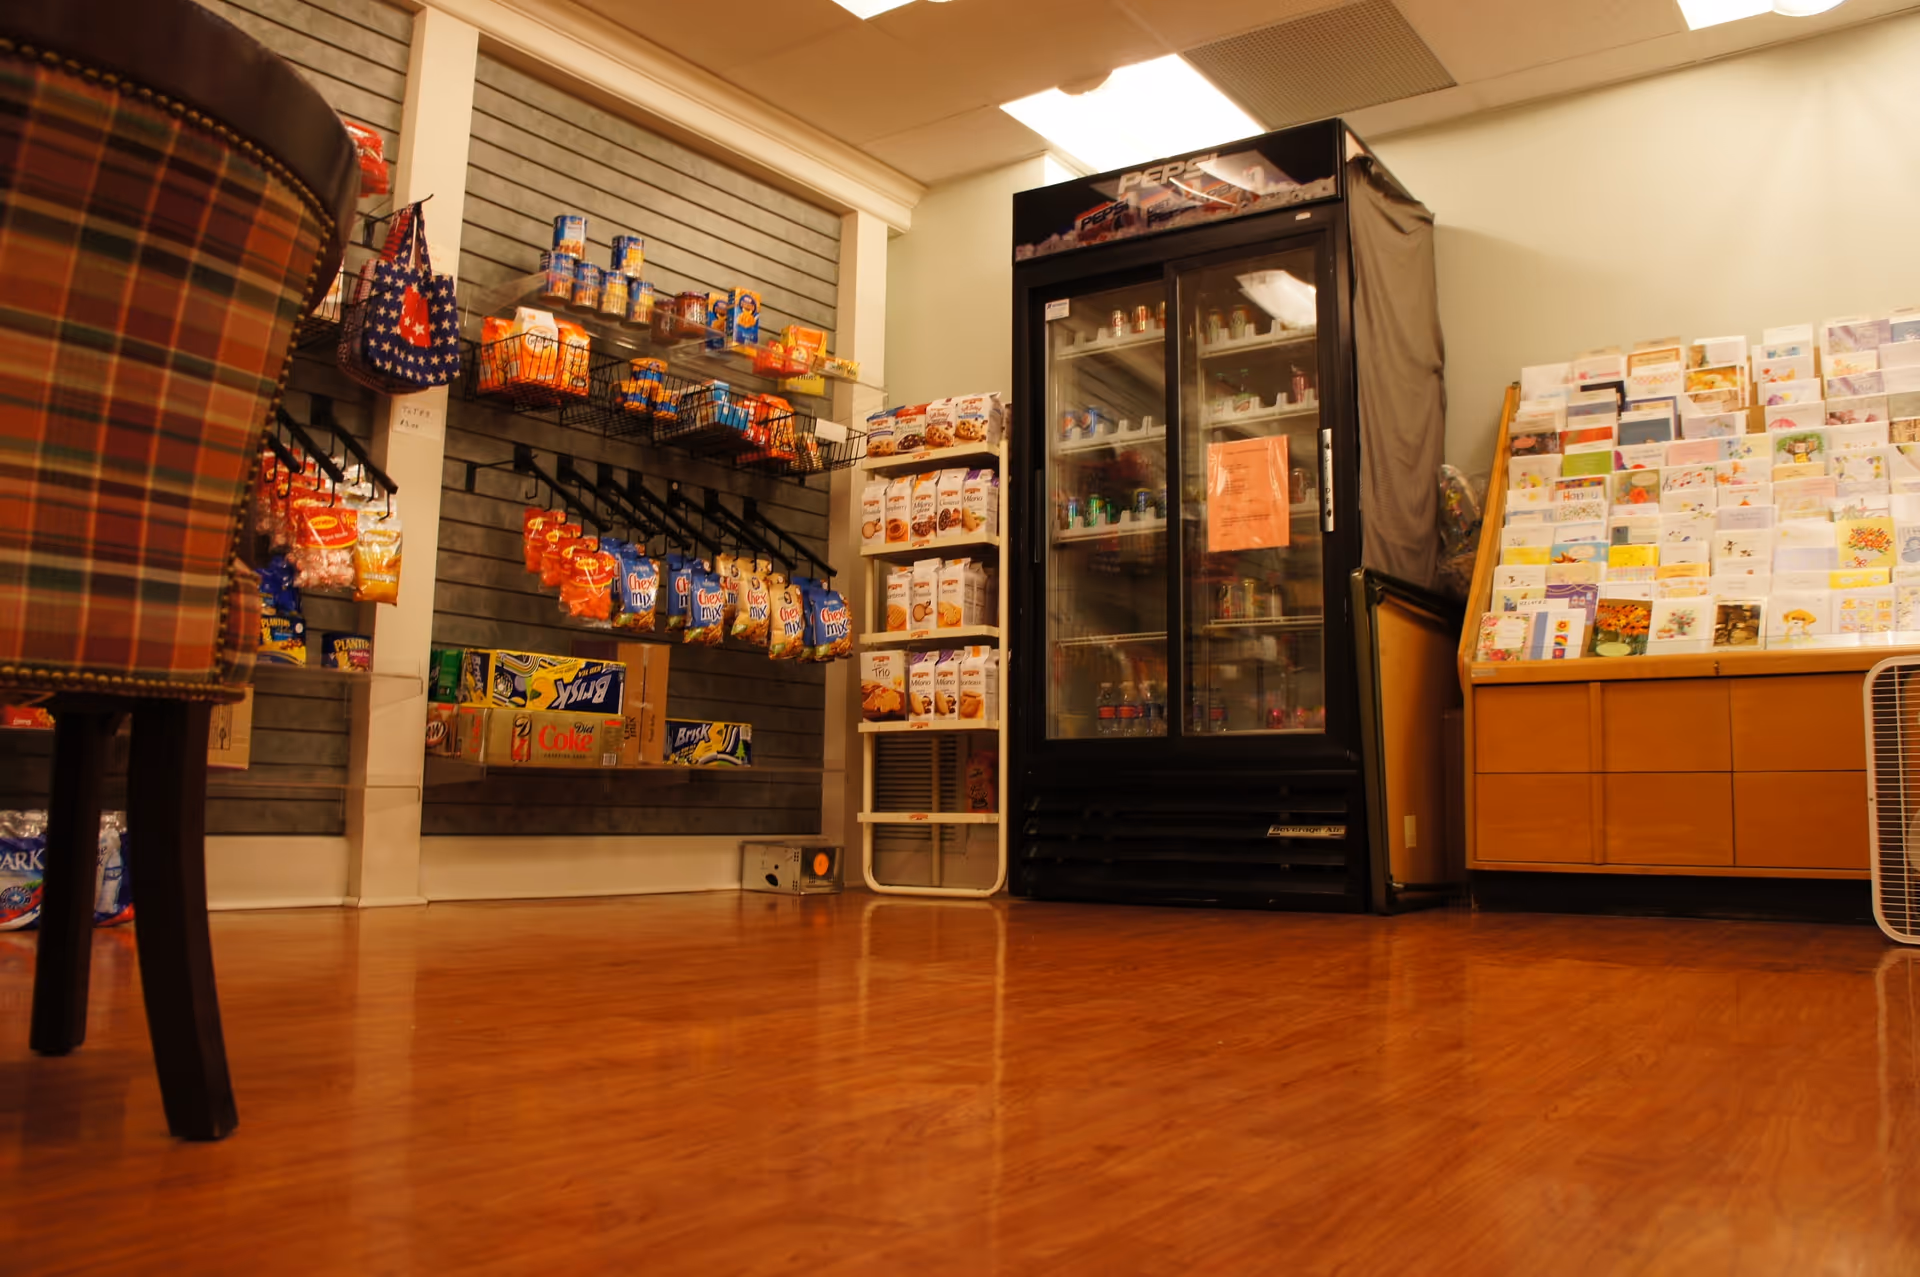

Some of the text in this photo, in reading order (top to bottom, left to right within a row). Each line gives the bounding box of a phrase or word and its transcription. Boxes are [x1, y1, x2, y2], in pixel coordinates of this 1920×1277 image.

[675, 576, 690, 595] Ch
[724, 576, 739, 593] Che
[697, 589, 724, 606] Chex
[746, 588, 768, 605] Chex
[700, 603, 723, 622] mix
[749, 604, 768, 620] mix
[779, 605, 800, 623] Chex
[820, 607, 846, 625] Chex
[784, 618, 802, 637] mix
[825, 618, 850, 637] mix
[871, 667, 891, 679] Trio
[574, 722, 595, 734] Diet
[538, 725, 594, 752] Coke
[0, 848, 44, 870] ARK
